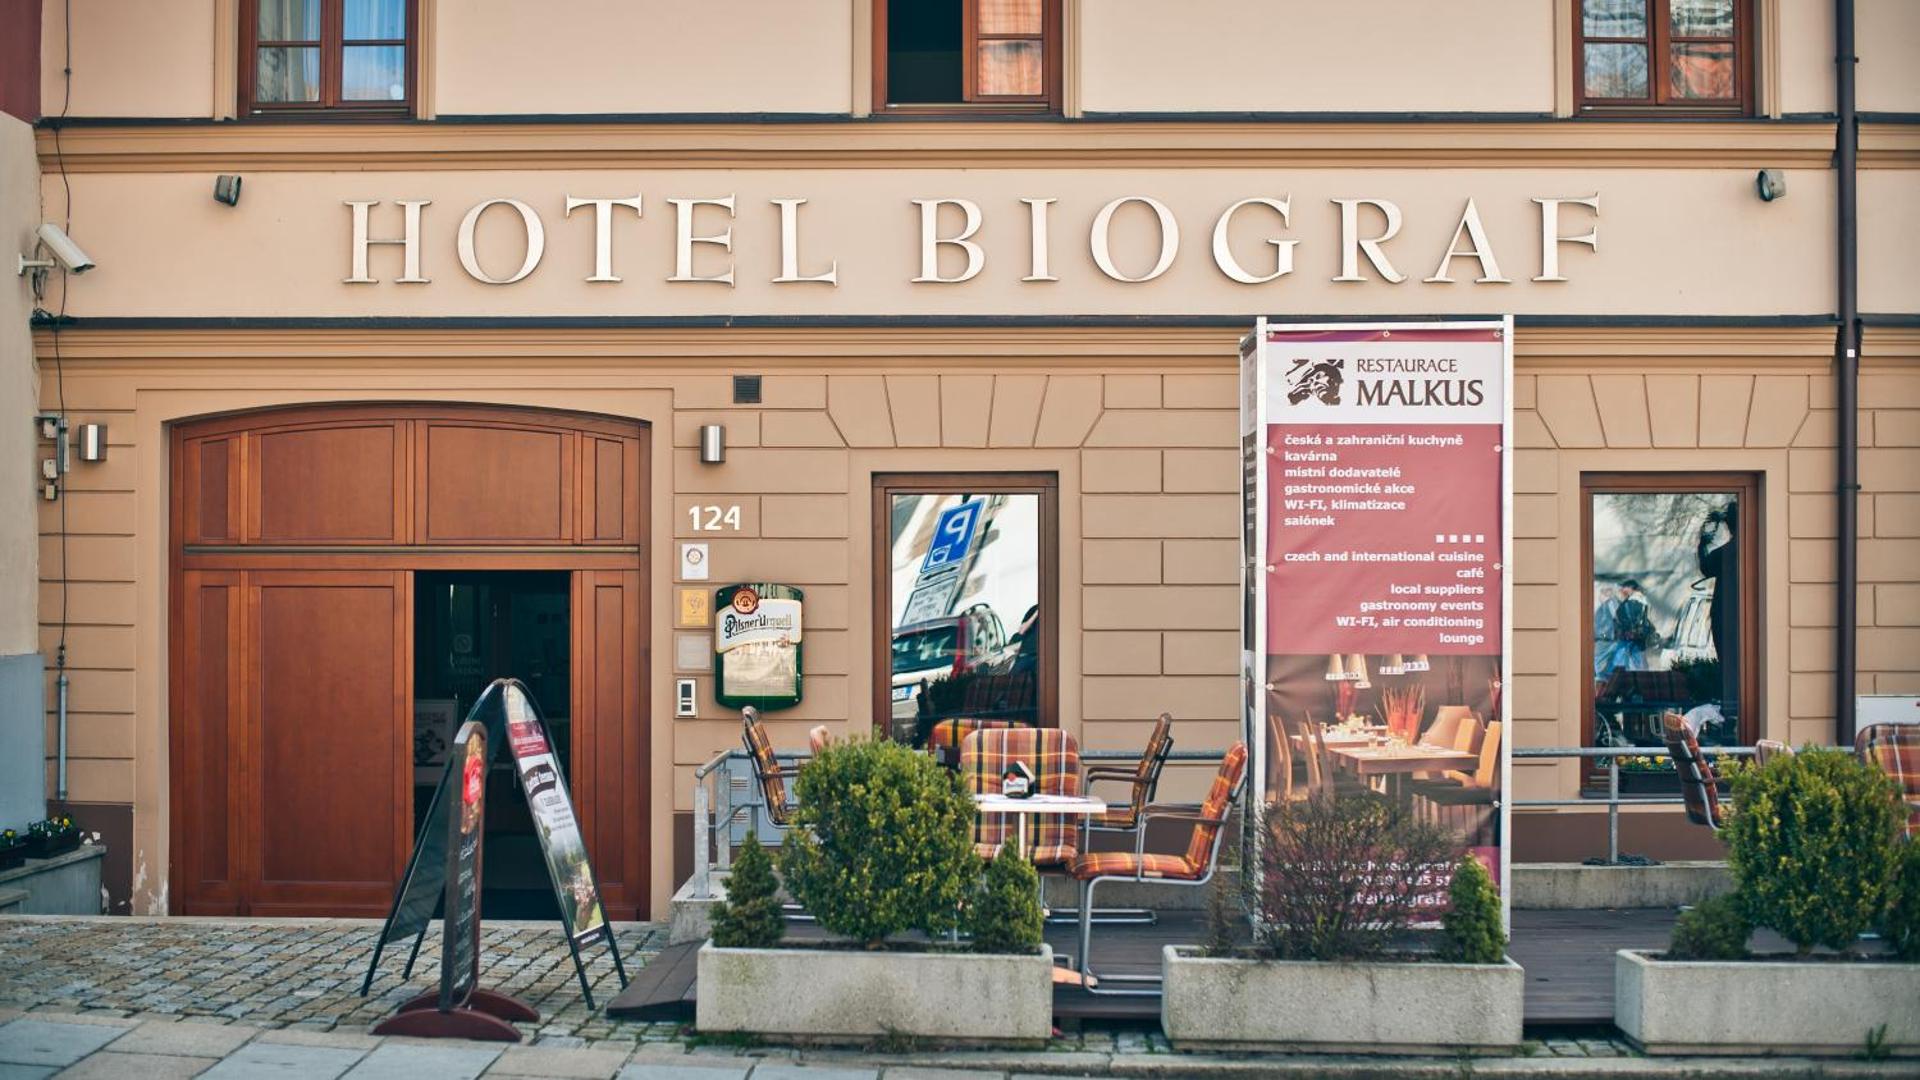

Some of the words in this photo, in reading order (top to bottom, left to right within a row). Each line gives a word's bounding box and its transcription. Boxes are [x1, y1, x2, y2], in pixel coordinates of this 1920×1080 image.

[342, 193, 838, 288] HOTEL
[911, 191, 1600, 285] BIOGRAF
[1357, 358, 1458, 373] RESTAURACE
[1356, 379, 1484, 407] MALKUS
[1284, 434, 1322, 446] česká
[1325, 436, 1334, 446] a
[1337, 434, 1405, 446] zahraniční
[1408, 434, 1464, 448] kuchyně
[1284, 451, 1338, 462] kavárna
[1284, 467, 1326, 478] místní
[1329, 467, 1402, 478] dodavatelé
[1284, 483, 1382, 496] gastronomické
[1384, 484, 1416, 495] akce
[1285, 500, 1328, 512] WI-FI,
[1331, 499, 1406, 511] klimatizace
[688, 506, 741, 531] 124
[1284, 515, 1336, 527] salónek
[1284, 550, 1320, 562] czech
[1323, 550, 1349, 562] and
[1352, 550, 1436, 562] international
[1438, 550, 1485, 562] cuisine
[1456, 567, 1485, 578] café
[1390, 583, 1421, 595] local
[1424, 583, 1485, 598] suppliers
[1360, 601, 1438, 614] gastronomy
[1440, 600, 1484, 612] events
[724, 614, 758, 639] Pilsner
[1336, 616, 1379, 628] WI-FI,
[1382, 616, 1401, 627] air
[1404, 615, 1484, 630] conditioning
[1439, 632, 1485, 646] lounge
